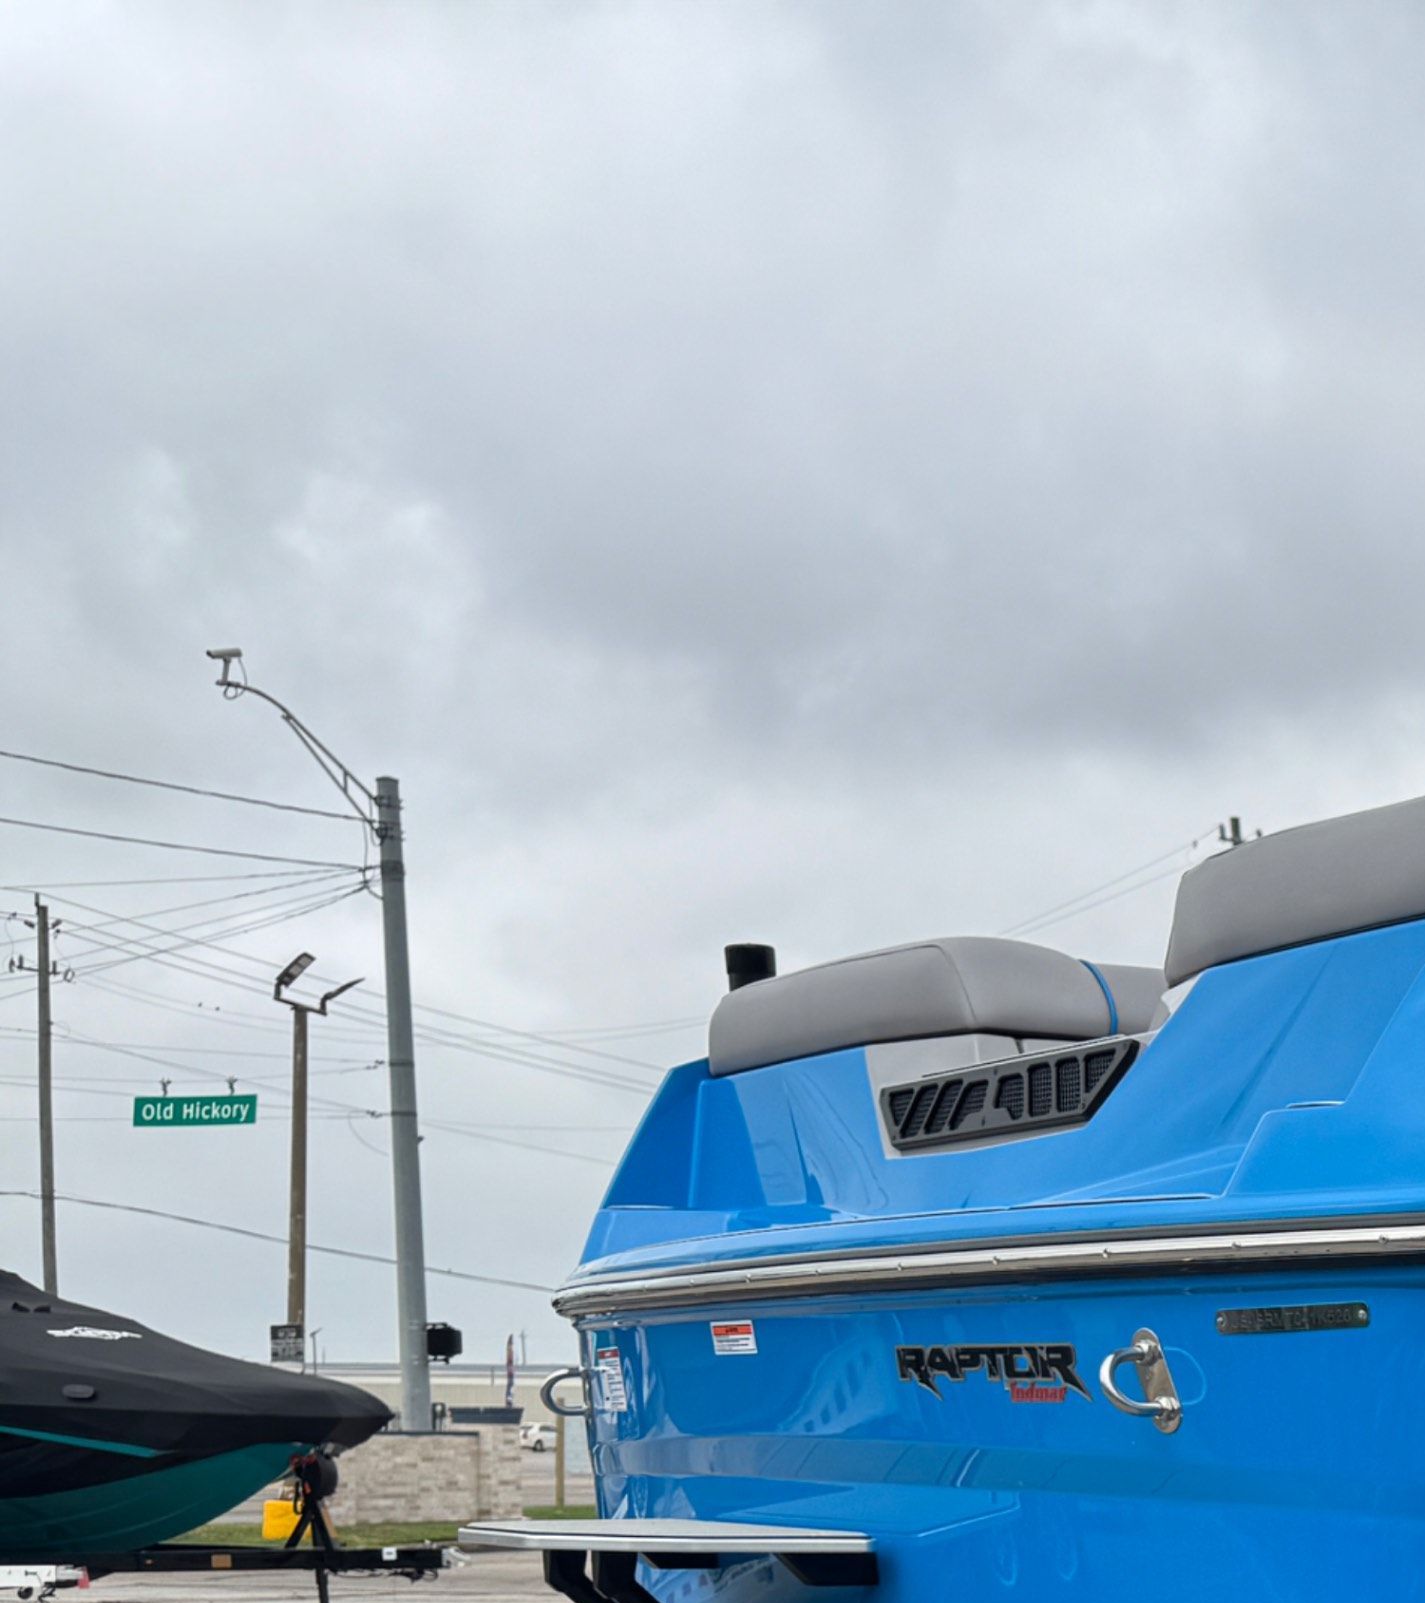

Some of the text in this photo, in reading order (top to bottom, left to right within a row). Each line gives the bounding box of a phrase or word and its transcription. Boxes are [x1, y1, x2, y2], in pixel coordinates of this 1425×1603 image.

[142, 1101, 250, 1122] Old Hickory
[895, 1343, 1094, 1402] RAPTOR
[1009, 1382, 1068, 1402] Indmar
